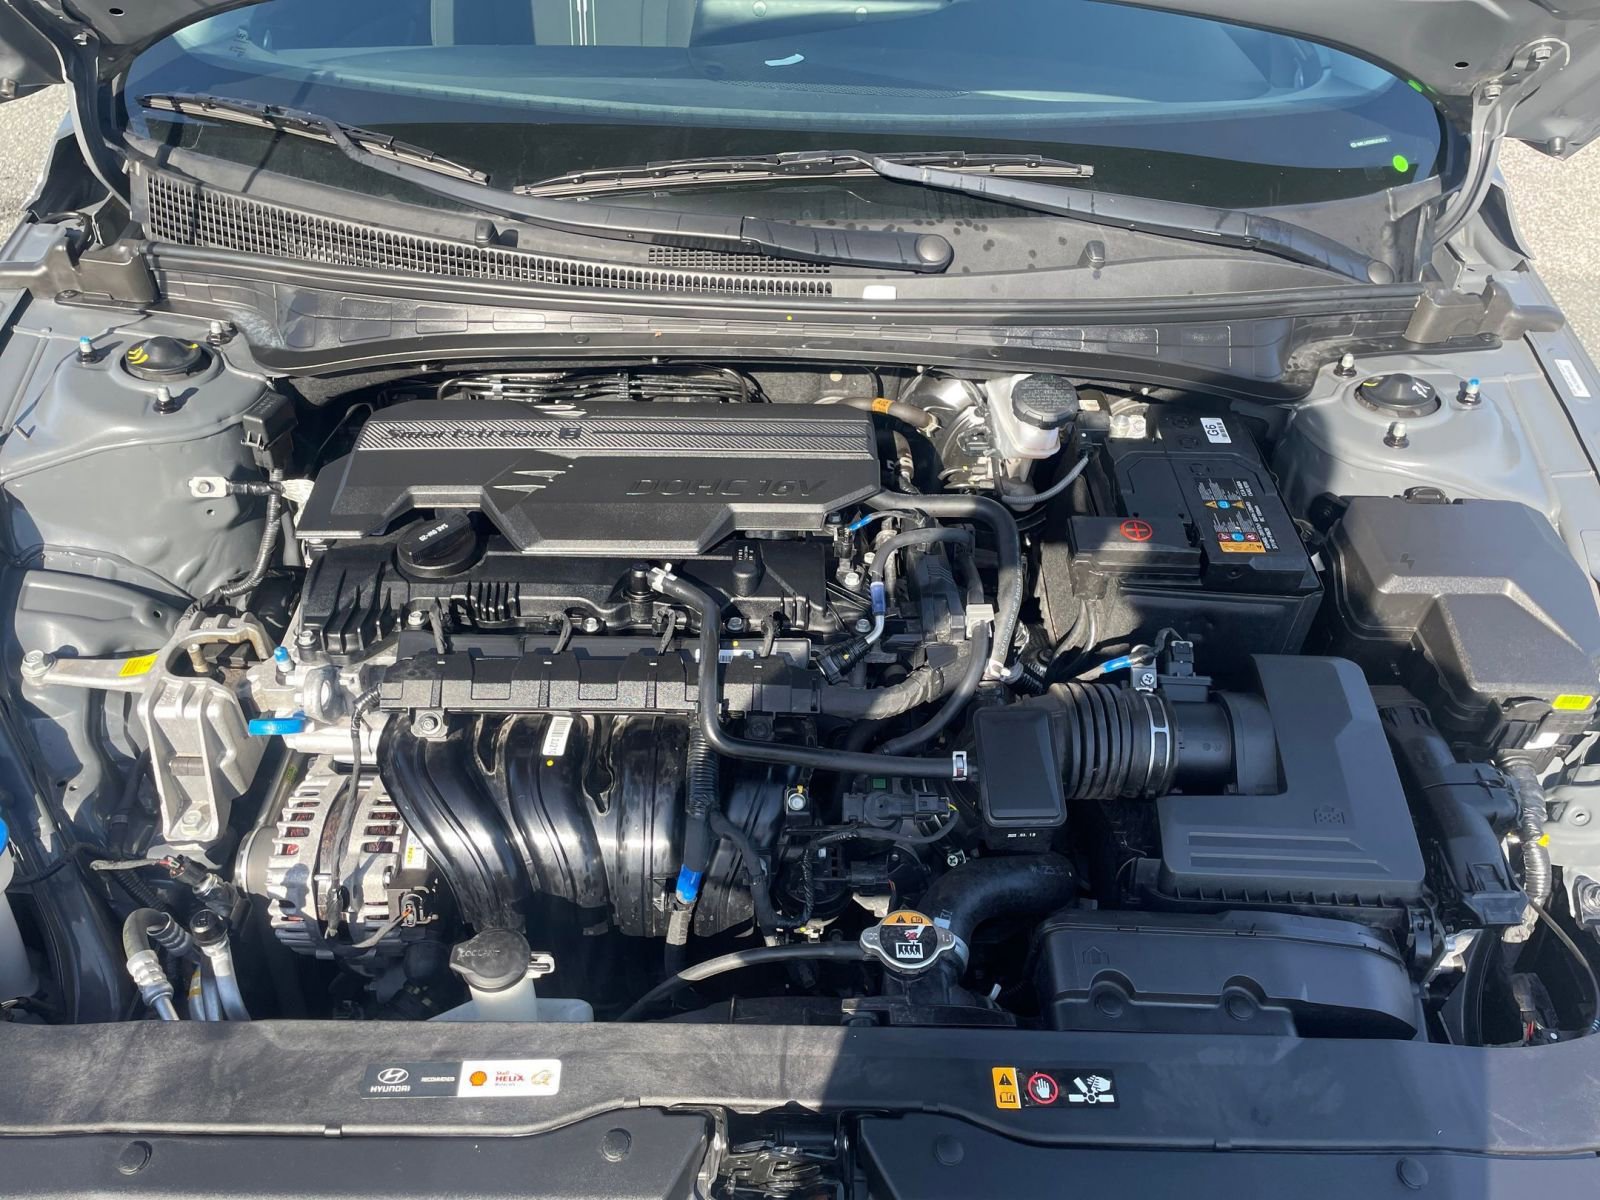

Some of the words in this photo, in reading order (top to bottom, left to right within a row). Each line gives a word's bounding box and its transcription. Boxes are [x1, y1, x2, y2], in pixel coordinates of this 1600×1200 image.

[1205, 424, 1220, 437] G6
[625, 479, 749, 496] DOHC
[757, 480, 828, 497] 16V
[495, 1074, 524, 1082] HELIX
[369, 1085, 411, 1093] HYUNDAI
